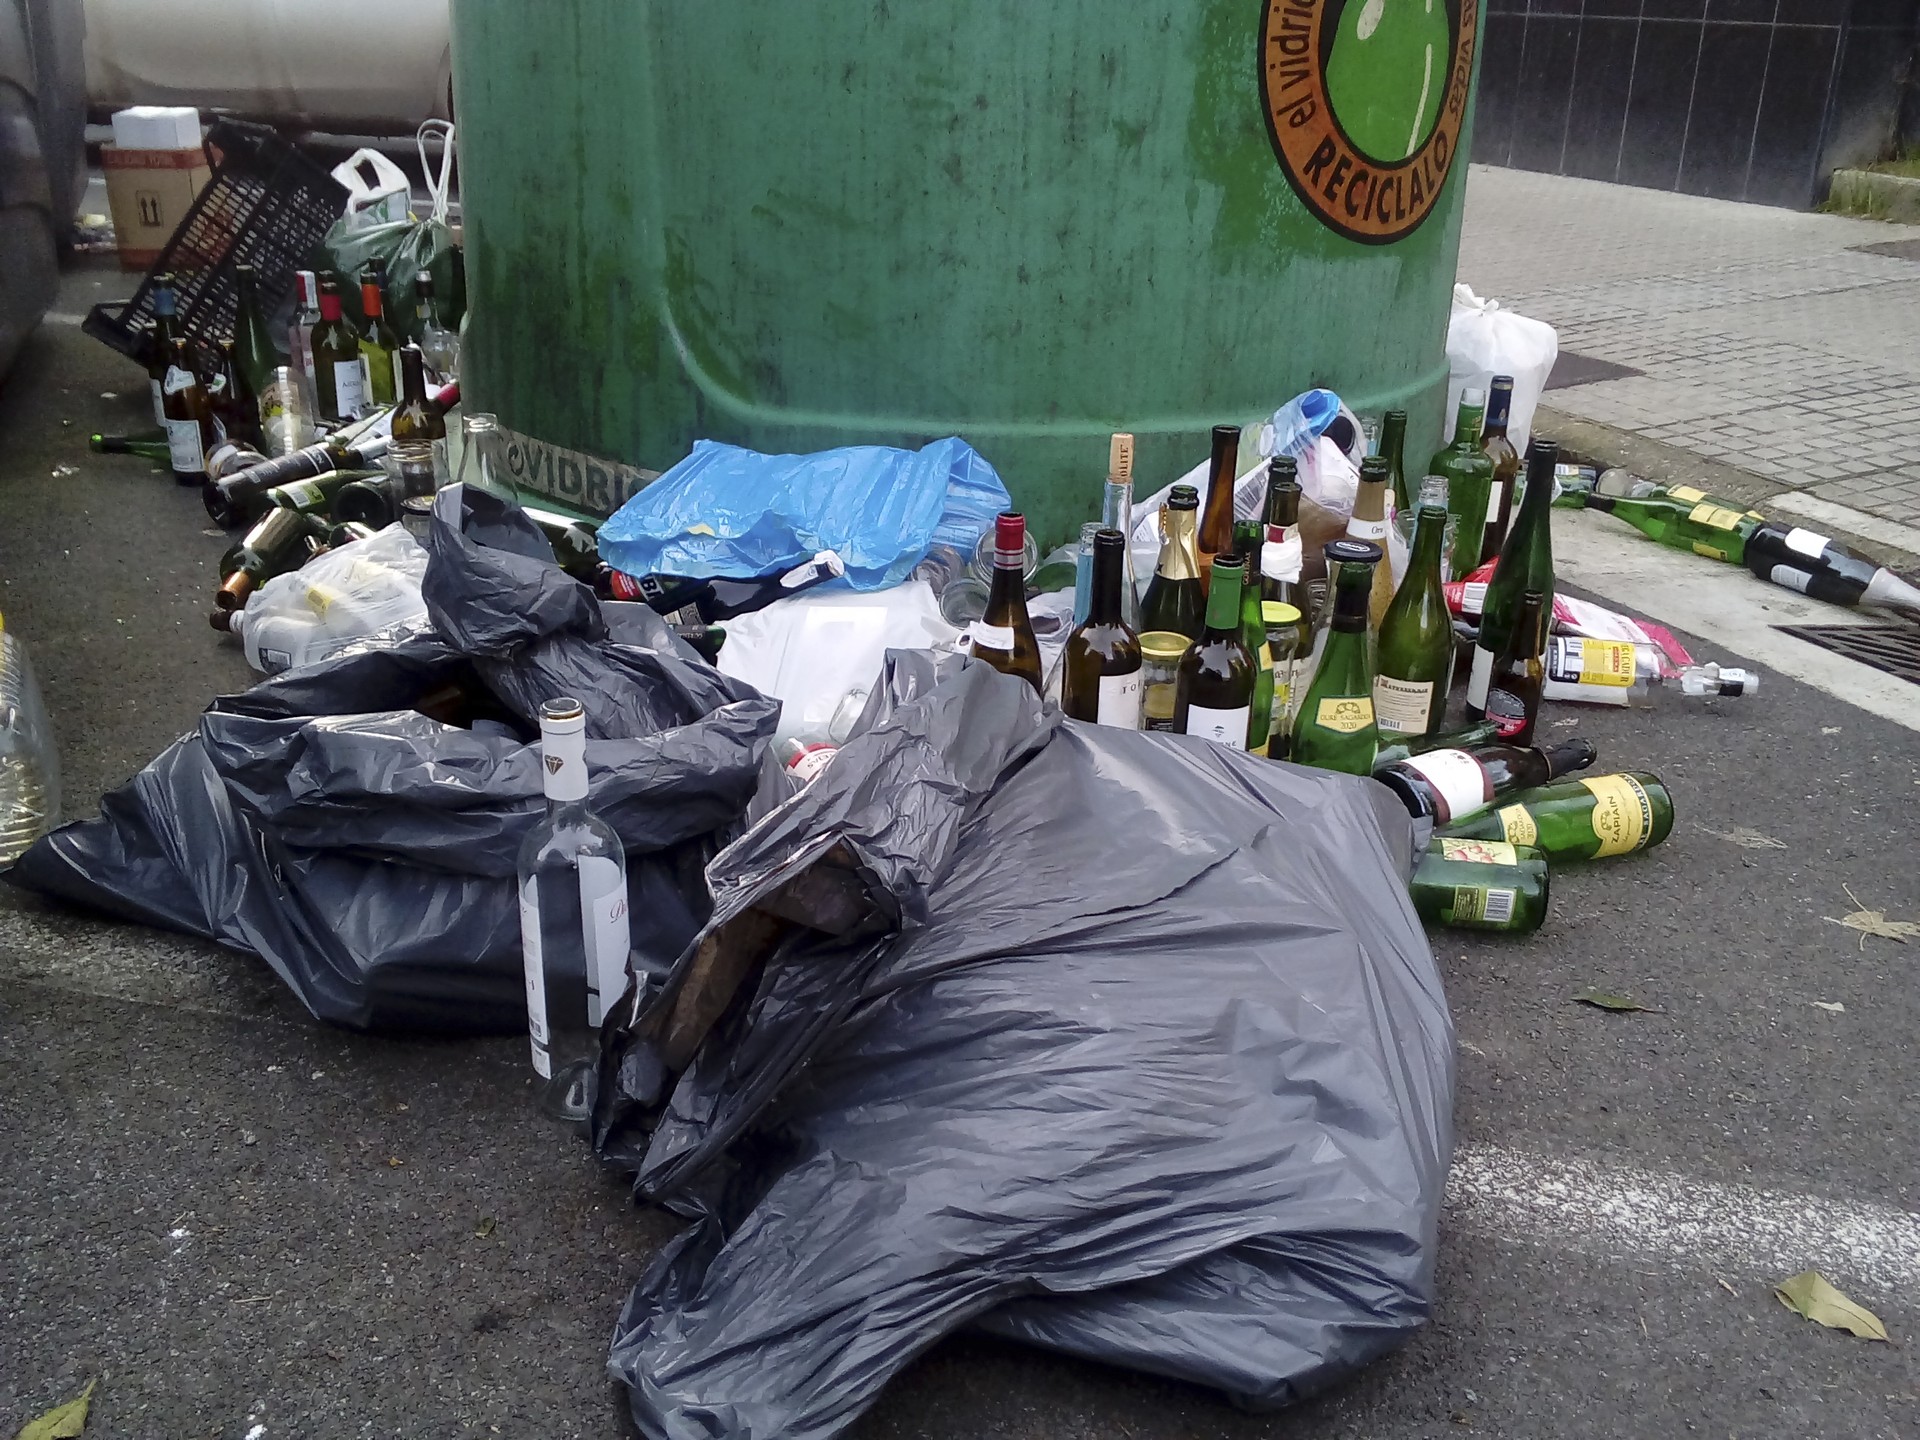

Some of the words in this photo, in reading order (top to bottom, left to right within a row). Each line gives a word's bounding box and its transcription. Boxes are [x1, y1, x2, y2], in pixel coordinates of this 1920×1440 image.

[1275, 90, 1317, 128] el
[1302, 130, 1449, 225] RECICLALO
[1340, 722, 1357, 730] 2020
[1607, 795, 1622, 844] ZAPIAIN
